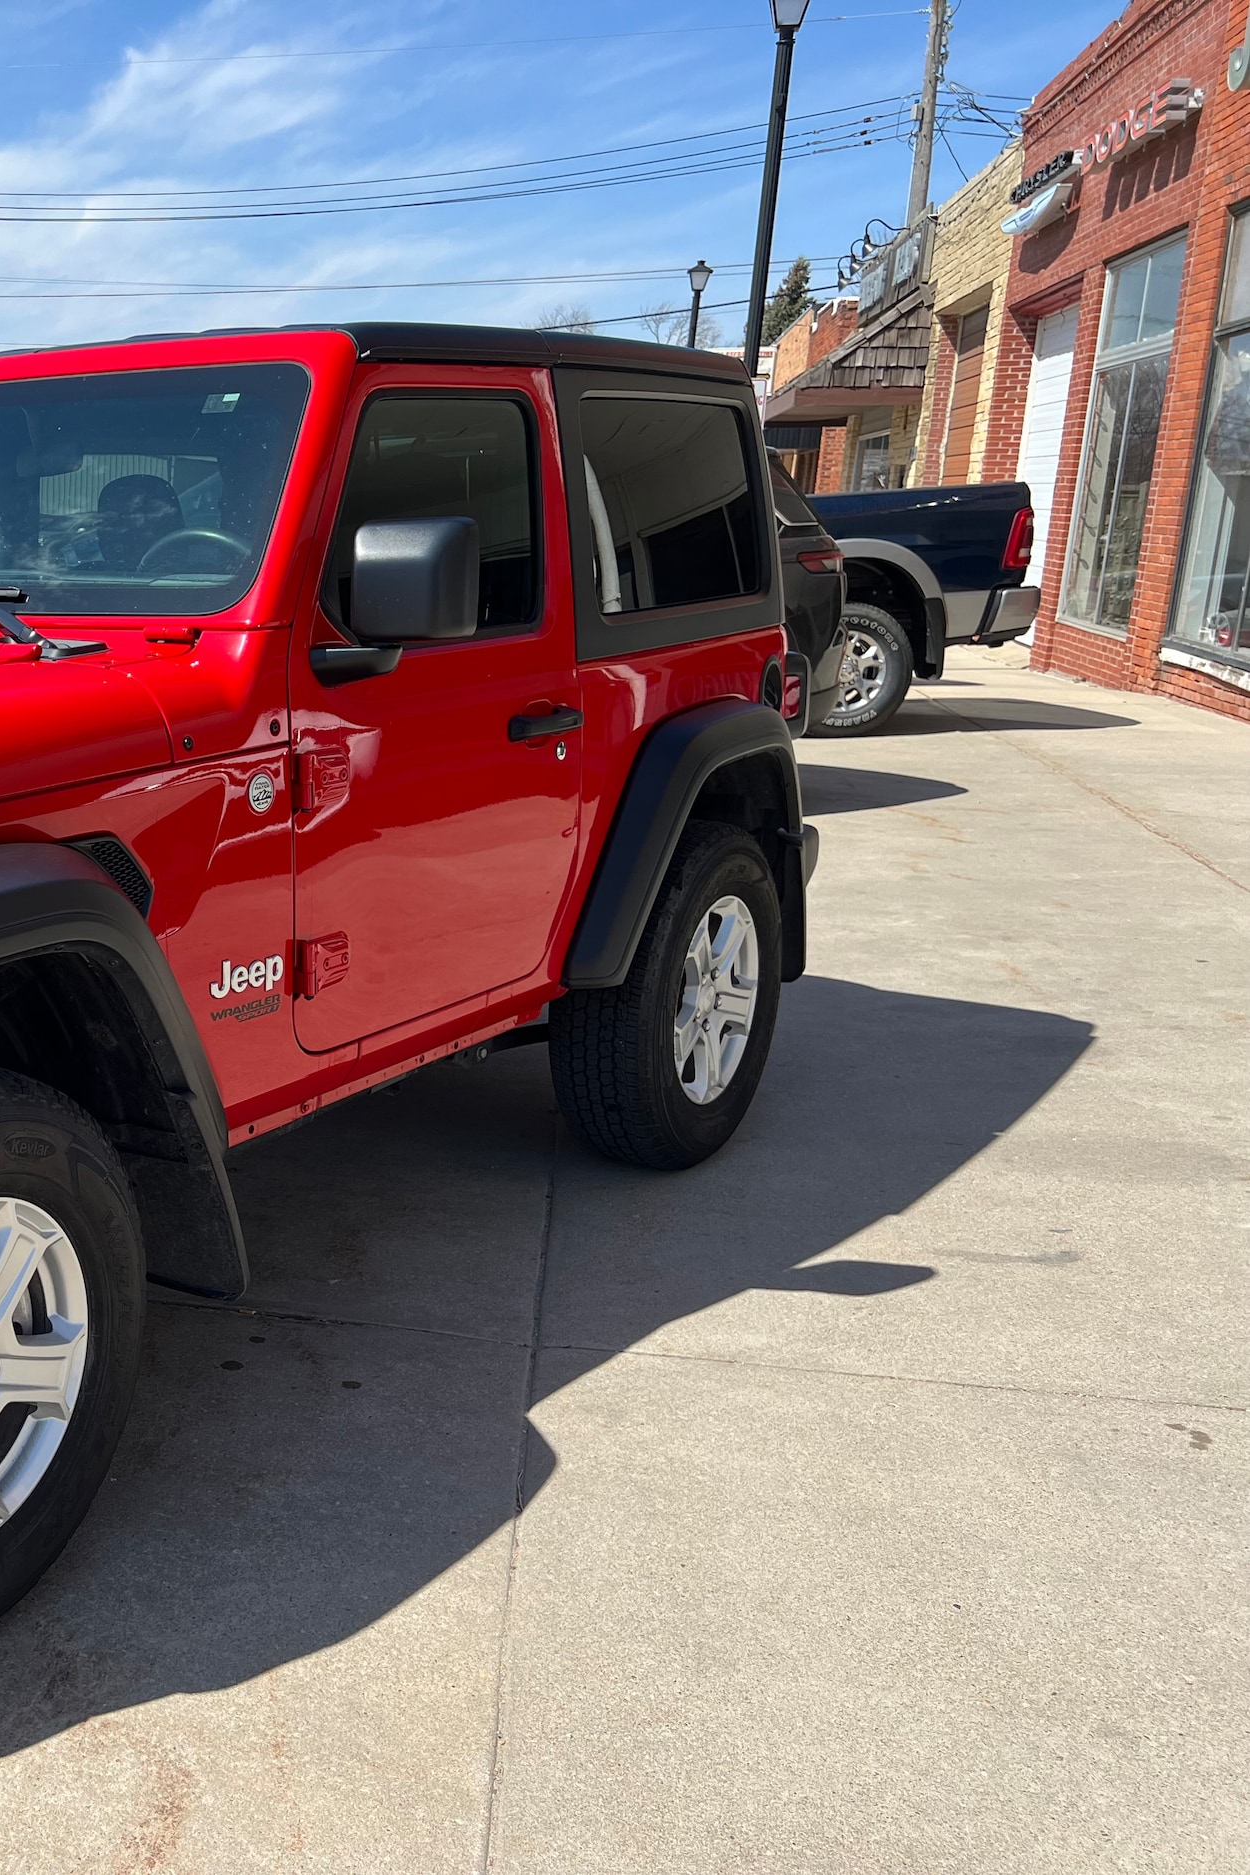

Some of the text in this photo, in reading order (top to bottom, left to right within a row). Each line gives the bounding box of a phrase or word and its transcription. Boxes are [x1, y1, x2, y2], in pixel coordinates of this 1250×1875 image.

[1081, 78, 1190, 176] DODGE
[1010, 151, 1073, 204] CHRYSLER
[210, 954, 284, 999] Jeep
[211, 993, 281, 1021] WRANGLER
[11, 1138, 50, 1157] Kevlar
